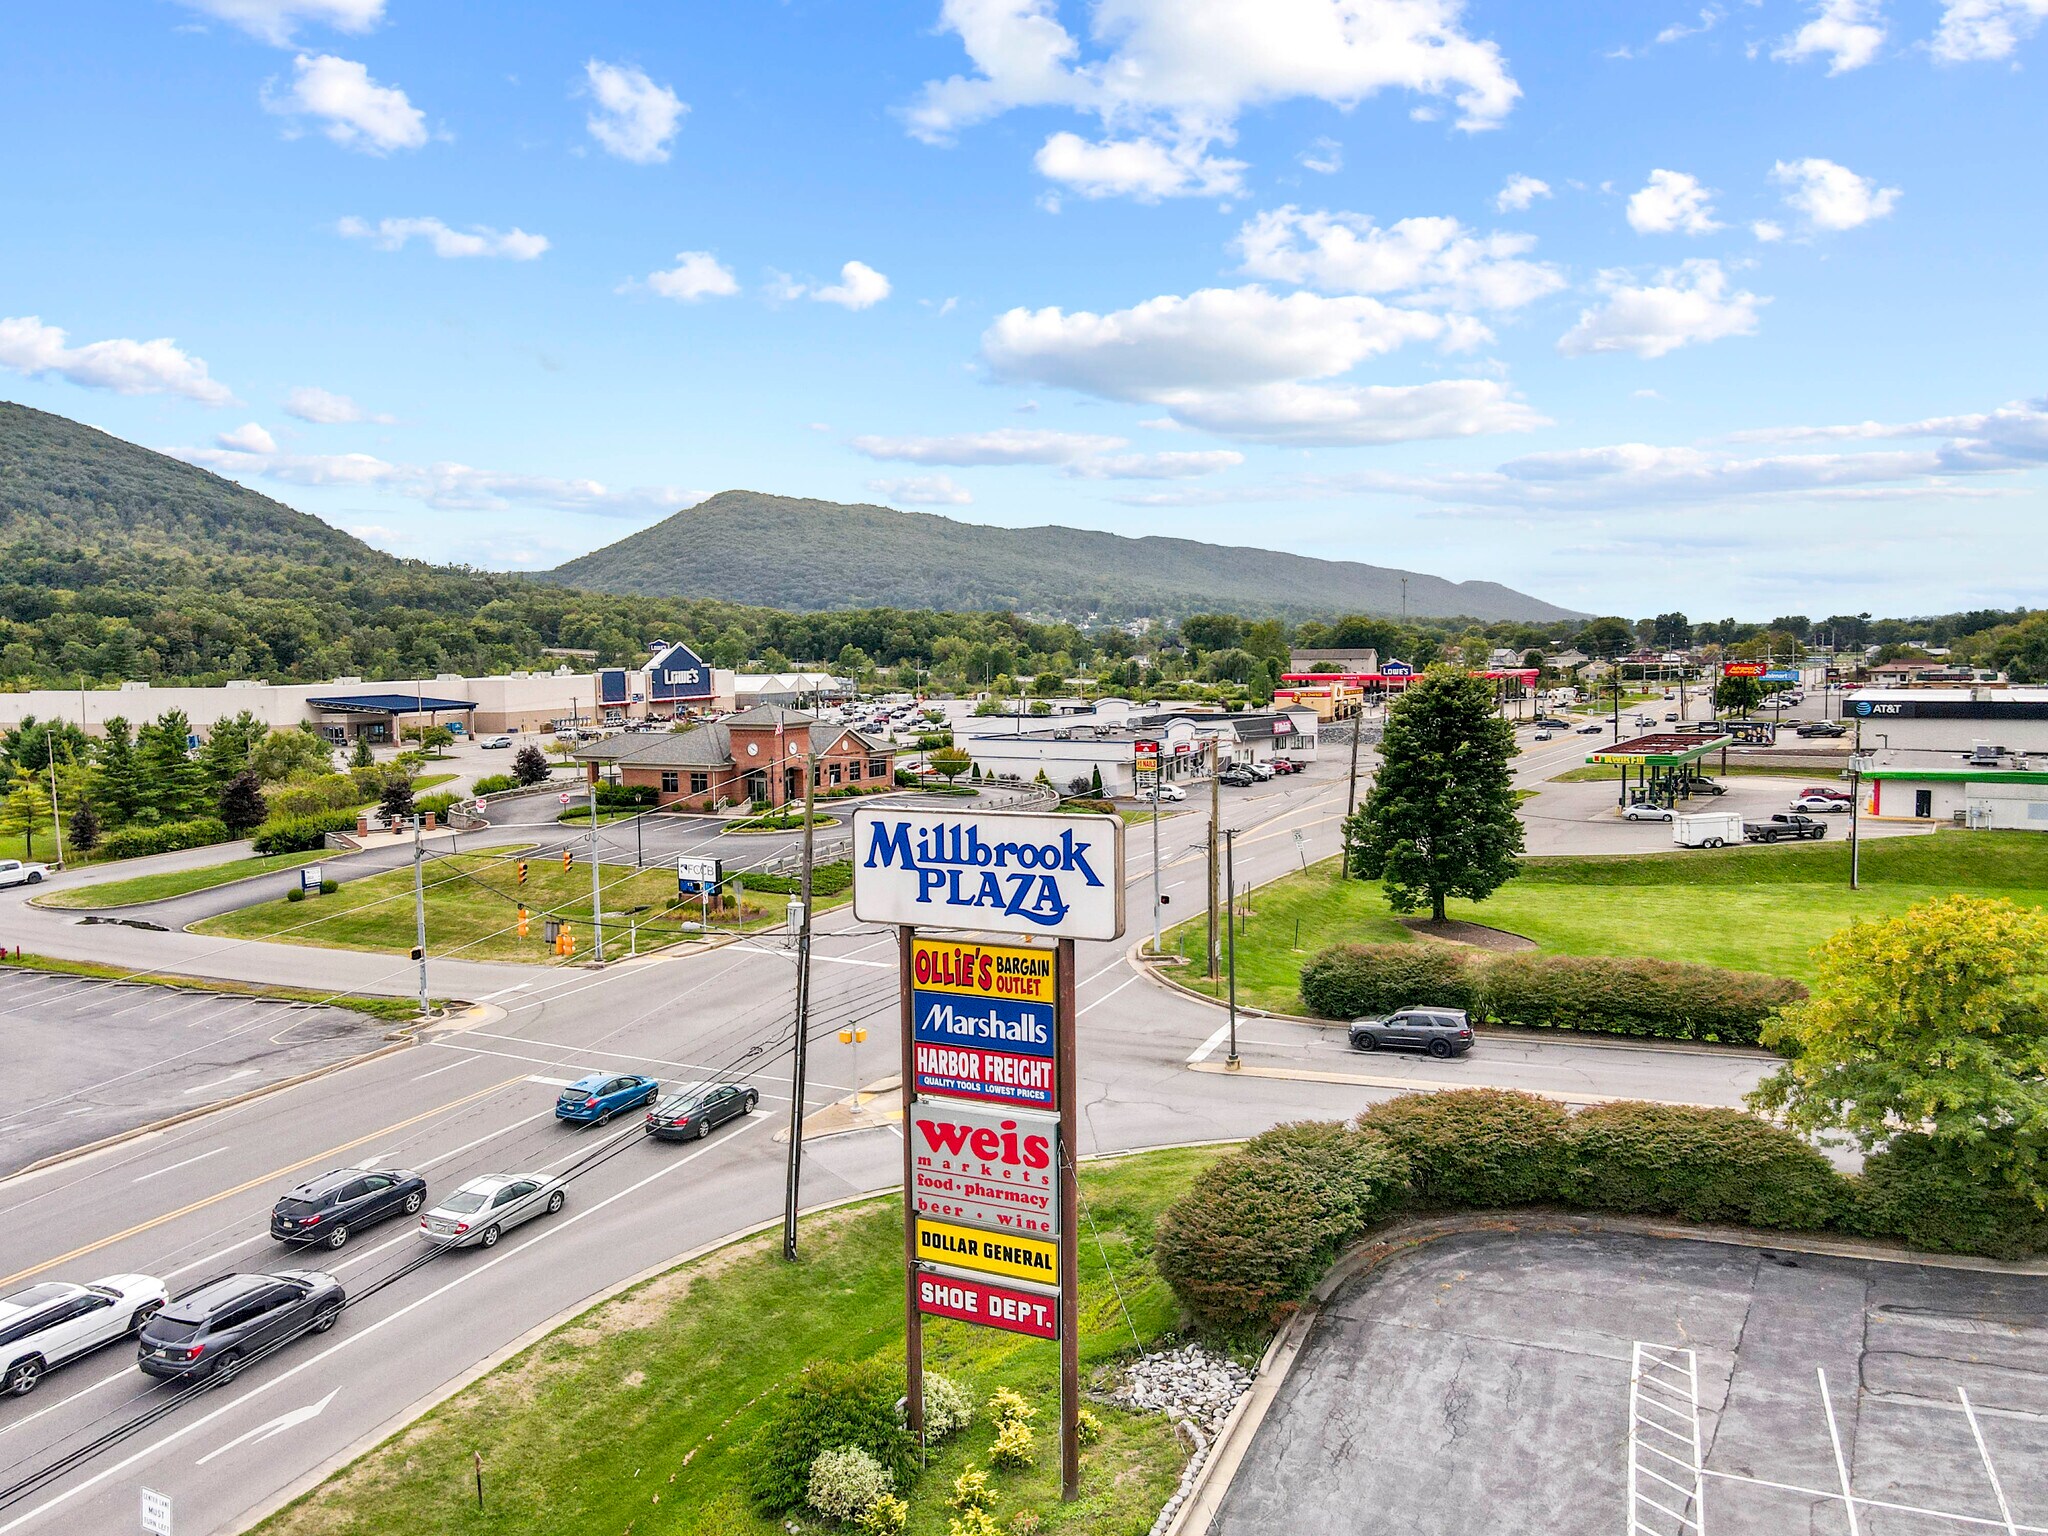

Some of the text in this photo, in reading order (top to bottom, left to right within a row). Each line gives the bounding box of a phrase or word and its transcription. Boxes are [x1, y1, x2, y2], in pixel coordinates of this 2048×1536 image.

[663, 668, 700, 684] LOWE'S
[1383, 667, 1409, 676] LOWE'S
[1873, 704, 1902, 714] AT&T
[1604, 755, 1631, 764] Kwik
[864, 820, 1105, 887] Millbrook
[687, 863, 715, 876] FCCB
[915, 867, 1070, 926] PLAZA
[996, 956, 1050, 977] BARGAIN
[996, 975, 1042, 996] OUTLET
[921, 1003, 1048, 1044] Marshalls
[917, 1047, 1052, 1088] HARBOR FREIGHT
[923, 1076, 1045, 1100] QUALITY TOOLS LOWEST PRICES
[915, 1119, 1050, 1169] weis
[917, 1155, 1049, 1185] markets
[917, 1173, 1049, 1209] food pharmacy
[917, 1197, 1050, 1232] beer wine
[921, 1230, 1053, 1270] DOLLAR GENERAL
[920, 1281, 1052, 1328] SHOE DEPT.
[144, 1517, 169, 1533] TURN LEFT
[148, 1506, 164, 1519] MUST
